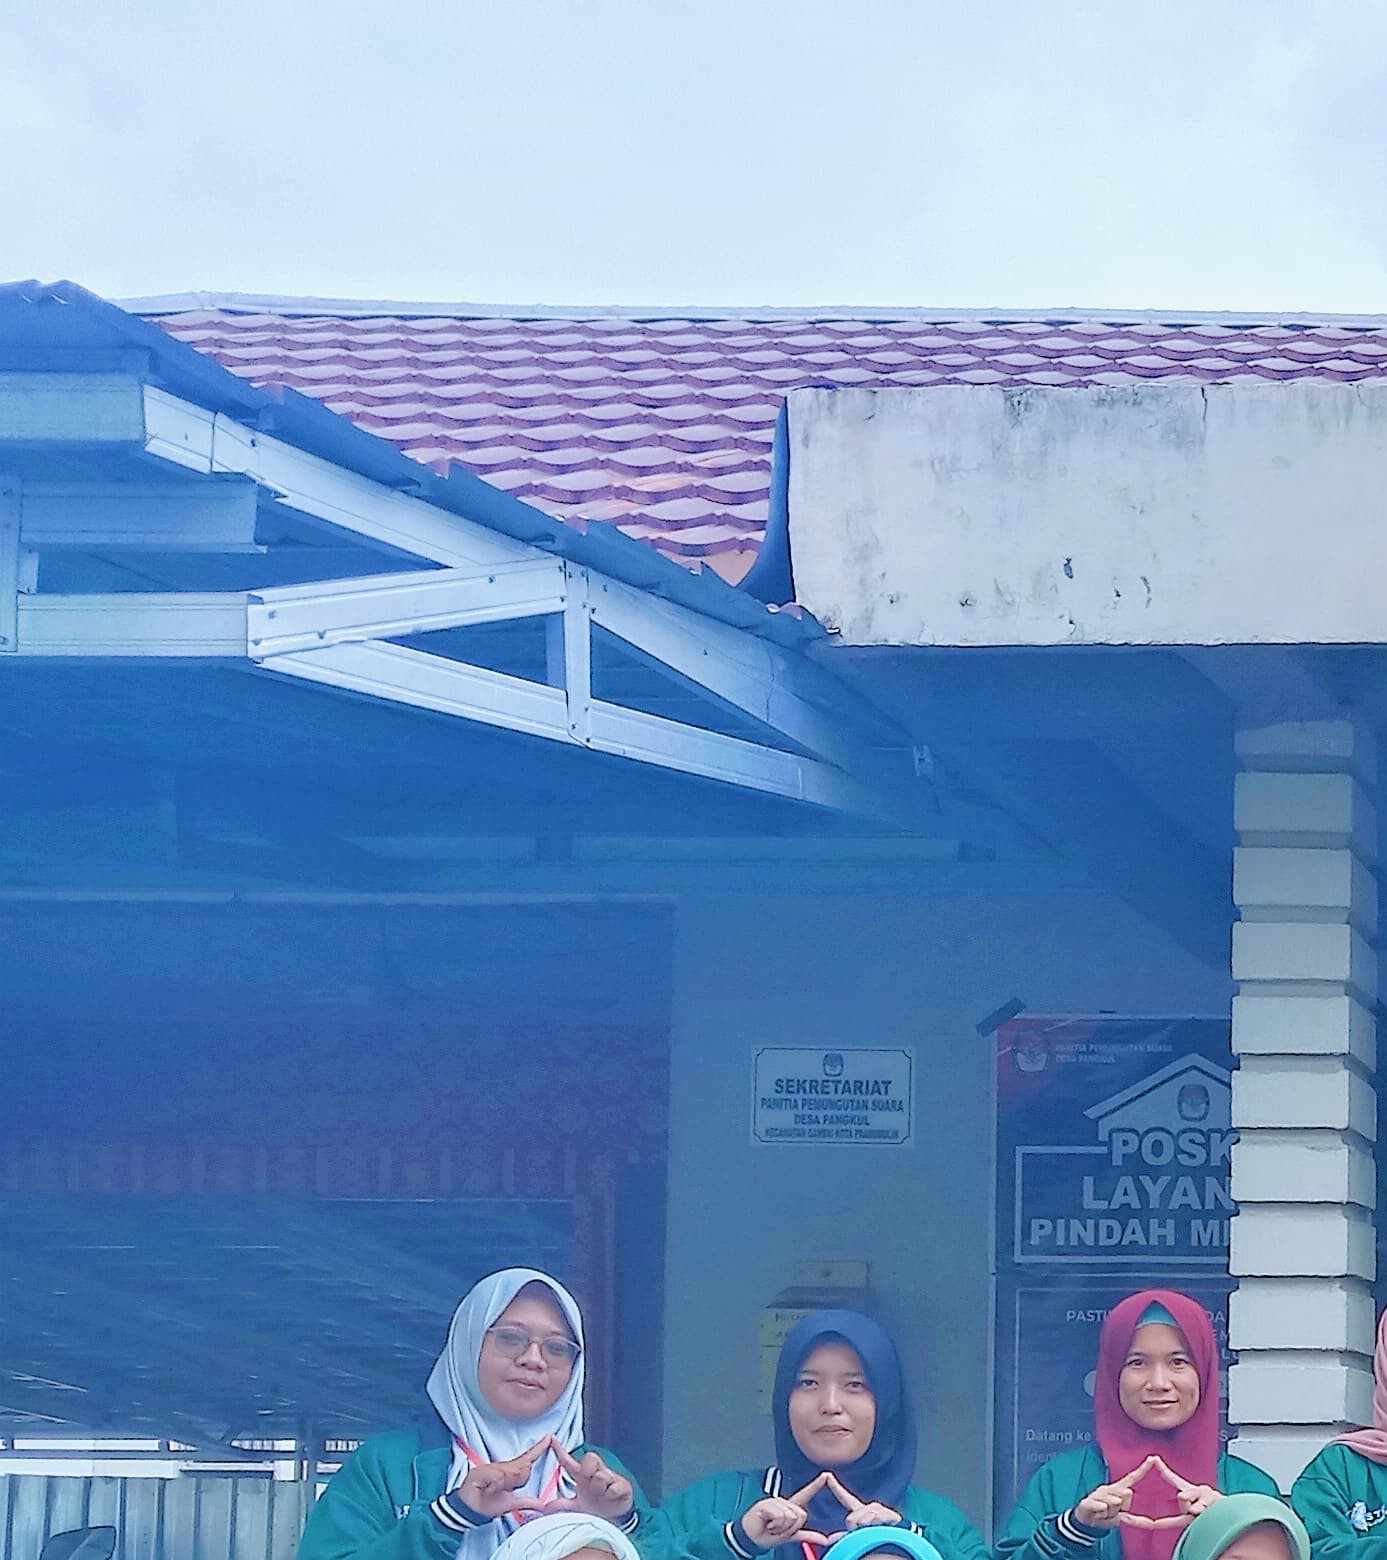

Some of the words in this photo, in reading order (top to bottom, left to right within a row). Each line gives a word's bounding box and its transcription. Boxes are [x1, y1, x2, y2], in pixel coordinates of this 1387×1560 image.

[774, 1078, 893, 1096] SEKRETARIAT
[794, 1114, 820, 1125] DESA
[823, 1115, 870, 1126] PANGKUL
[1109, 1129, 1239, 1166] POSK
[1082, 1175, 1235, 1210] LAYAN
[1030, 1218, 1175, 1247] PINDAH
[1076, 1429, 1092, 1441] ke
